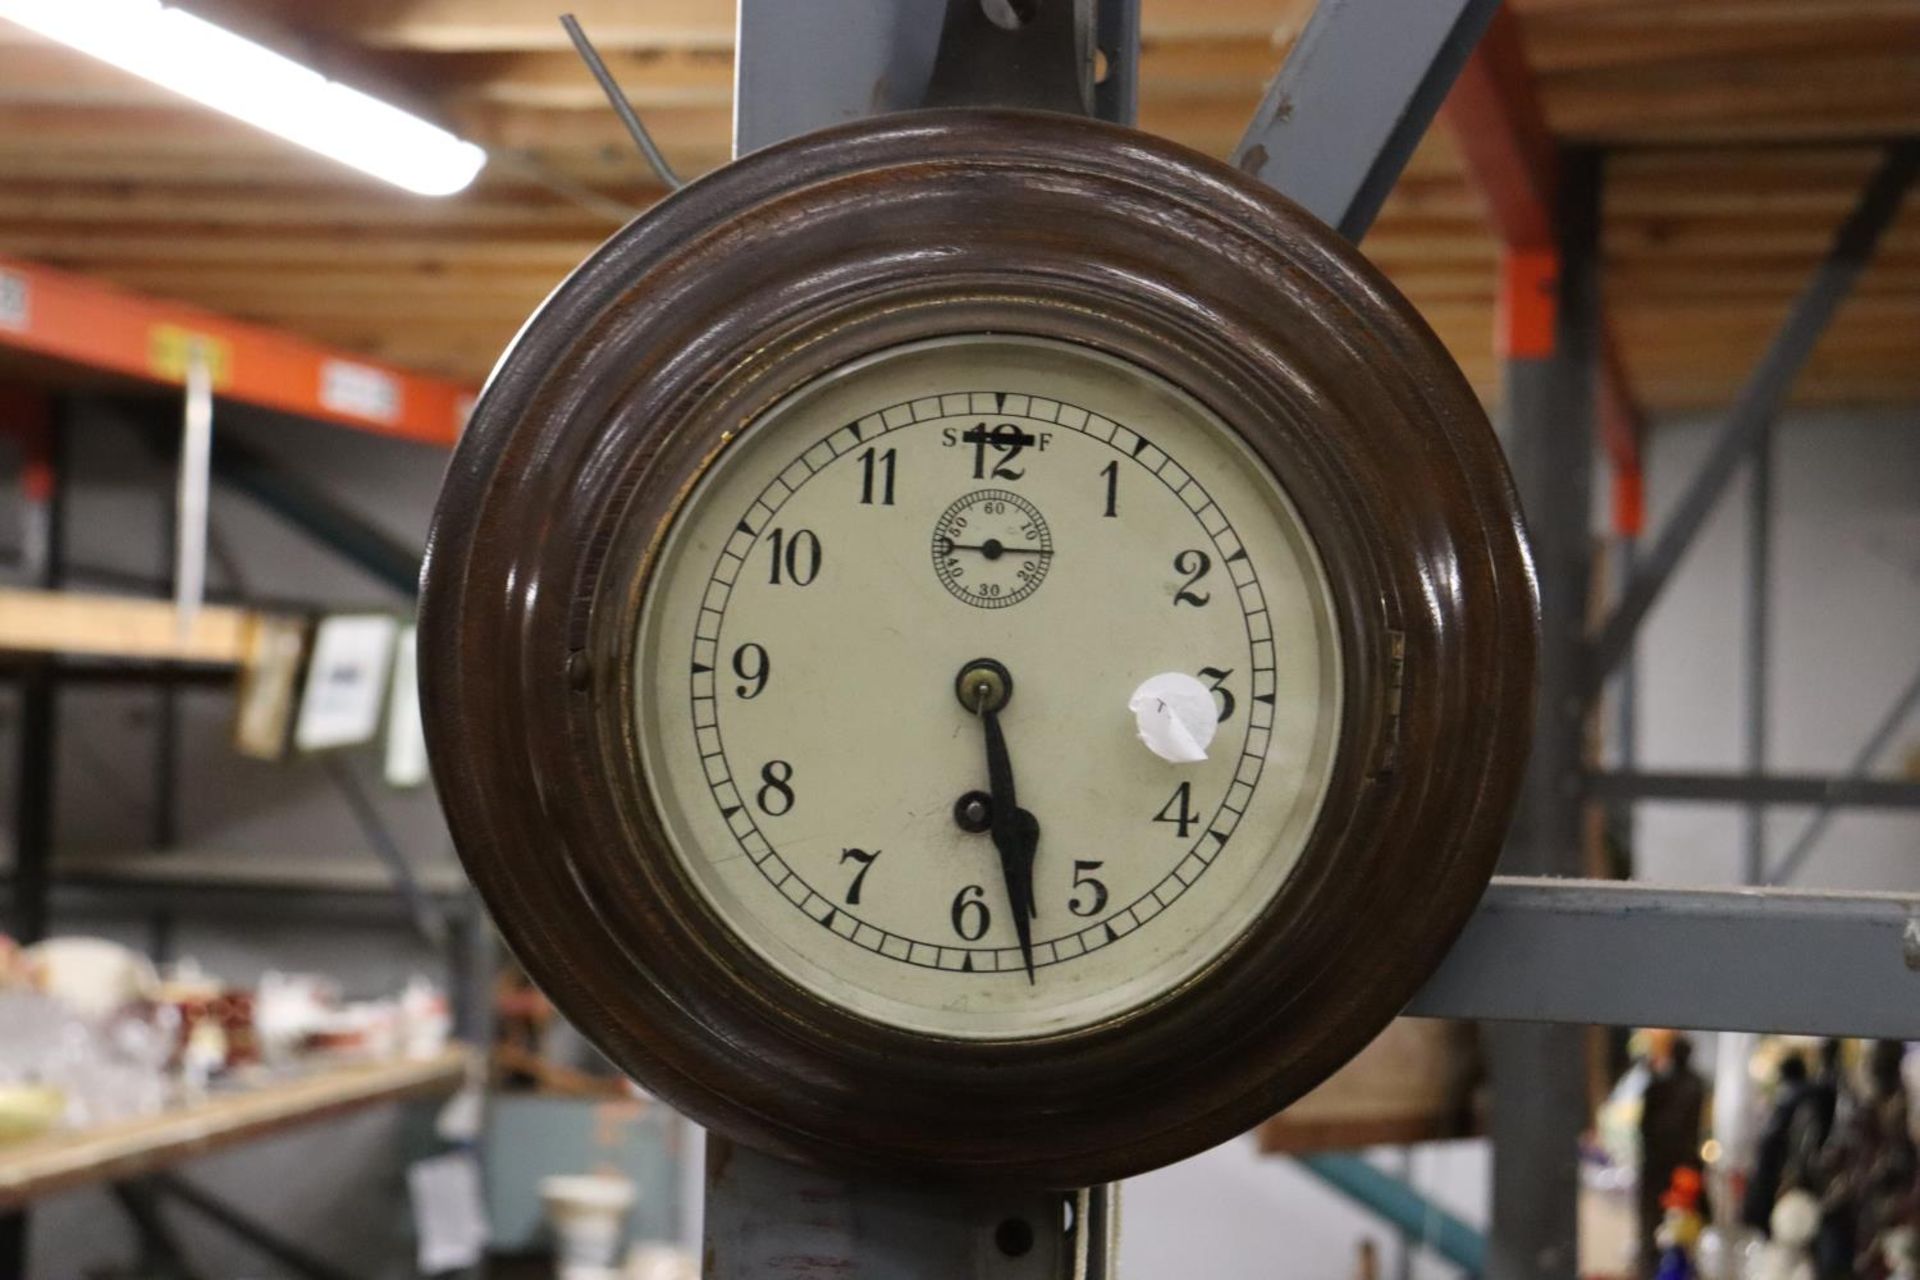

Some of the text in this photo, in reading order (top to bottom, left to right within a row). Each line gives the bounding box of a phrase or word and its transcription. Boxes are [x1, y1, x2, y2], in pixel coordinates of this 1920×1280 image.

[942, 427, 1053, 452] S F
[970, 422, 1026, 481] 12
[856, 446, 897, 506] 11
[1100, 459, 1119, 519] 1
[949, 517, 968, 538] 50
[984, 502, 1005, 515] 60
[1021, 522, 1038, 541] 10
[762, 526, 823, 587] 10
[947, 558, 964, 578] 40
[1017, 561, 1036, 581] 20
[1173, 549, 1211, 608] 2
[979, 583, 1001, 597] 30
[732, 642, 771, 700] 9
[756, 759, 795, 817] 8
[1153, 781, 1200, 838] 4
[838, 847, 882, 906] 7
[1067, 860, 1109, 919] 5
[951, 884, 991, 942] 6
